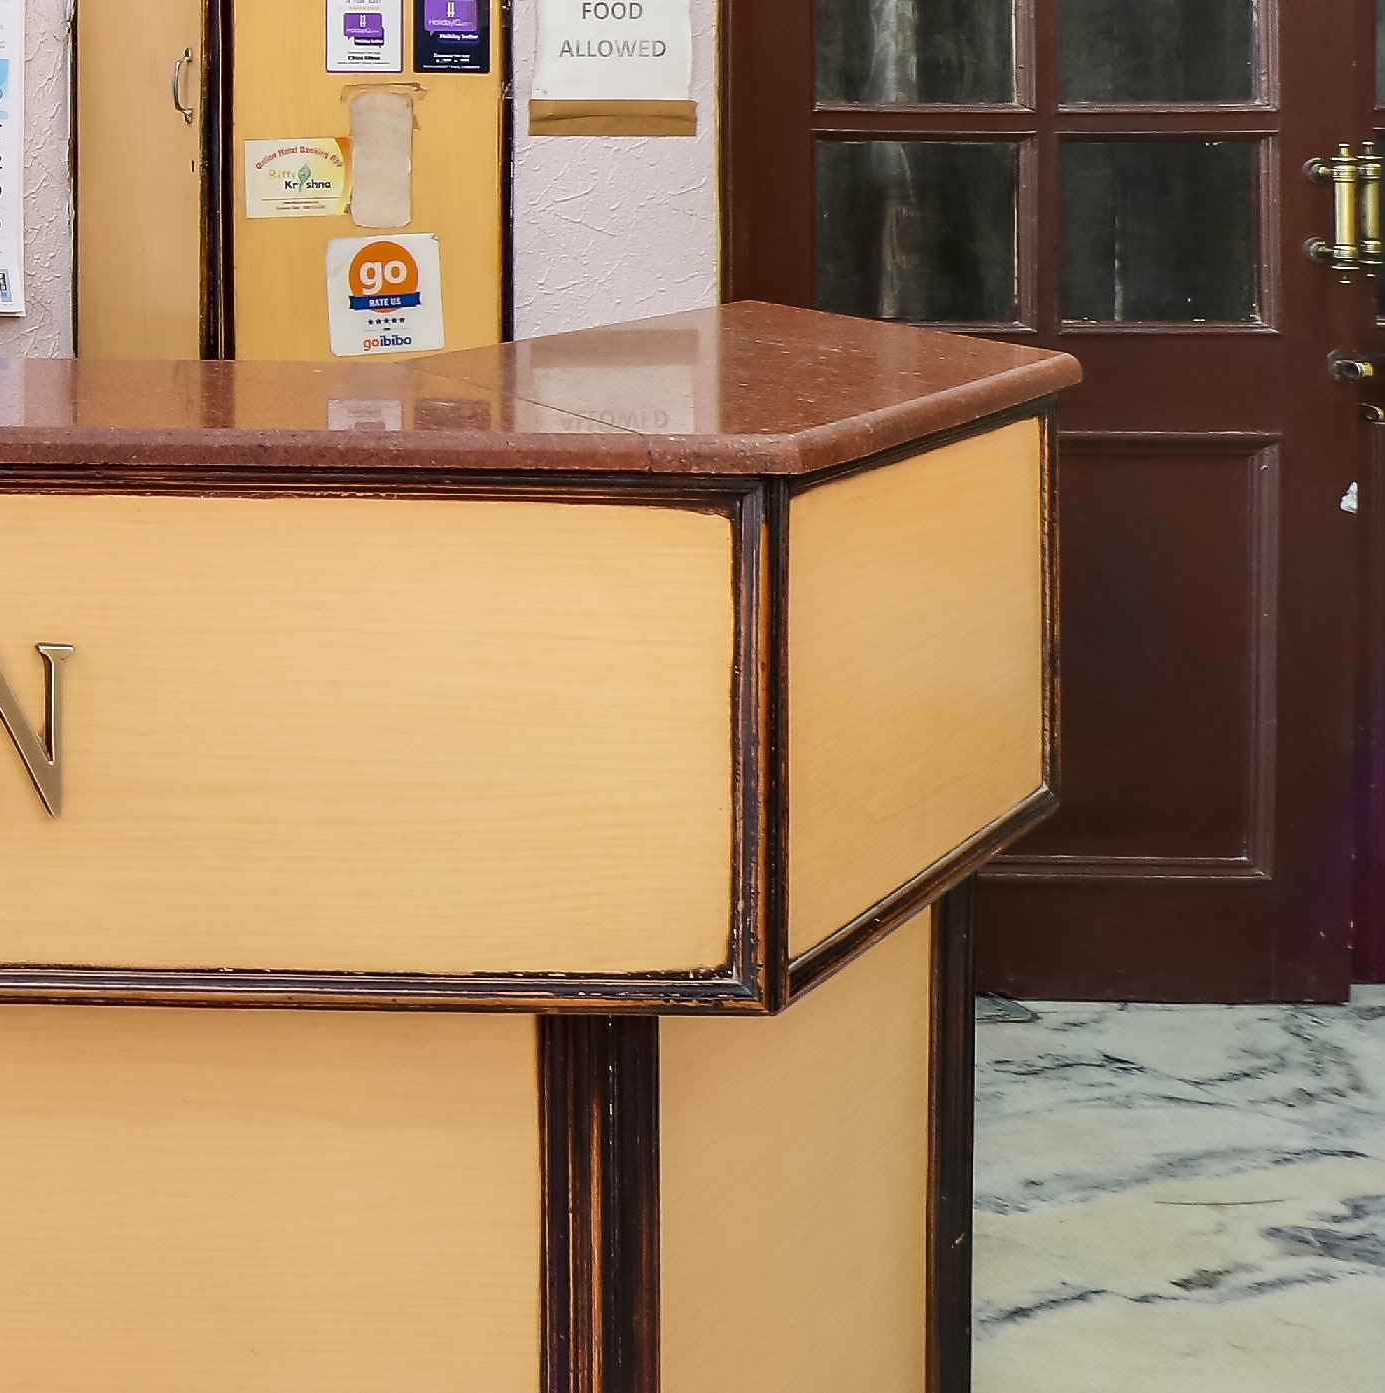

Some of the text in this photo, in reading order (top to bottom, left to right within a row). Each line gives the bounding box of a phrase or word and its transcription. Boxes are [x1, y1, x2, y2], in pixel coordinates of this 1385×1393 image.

[582, 2, 643, 19] FOOD
[559, 40, 666, 57] ALLOWED
[359, 260, 407, 296] go
[369, 297, 401, 307] RATE US
[363, 335, 412, 352] goibibo
